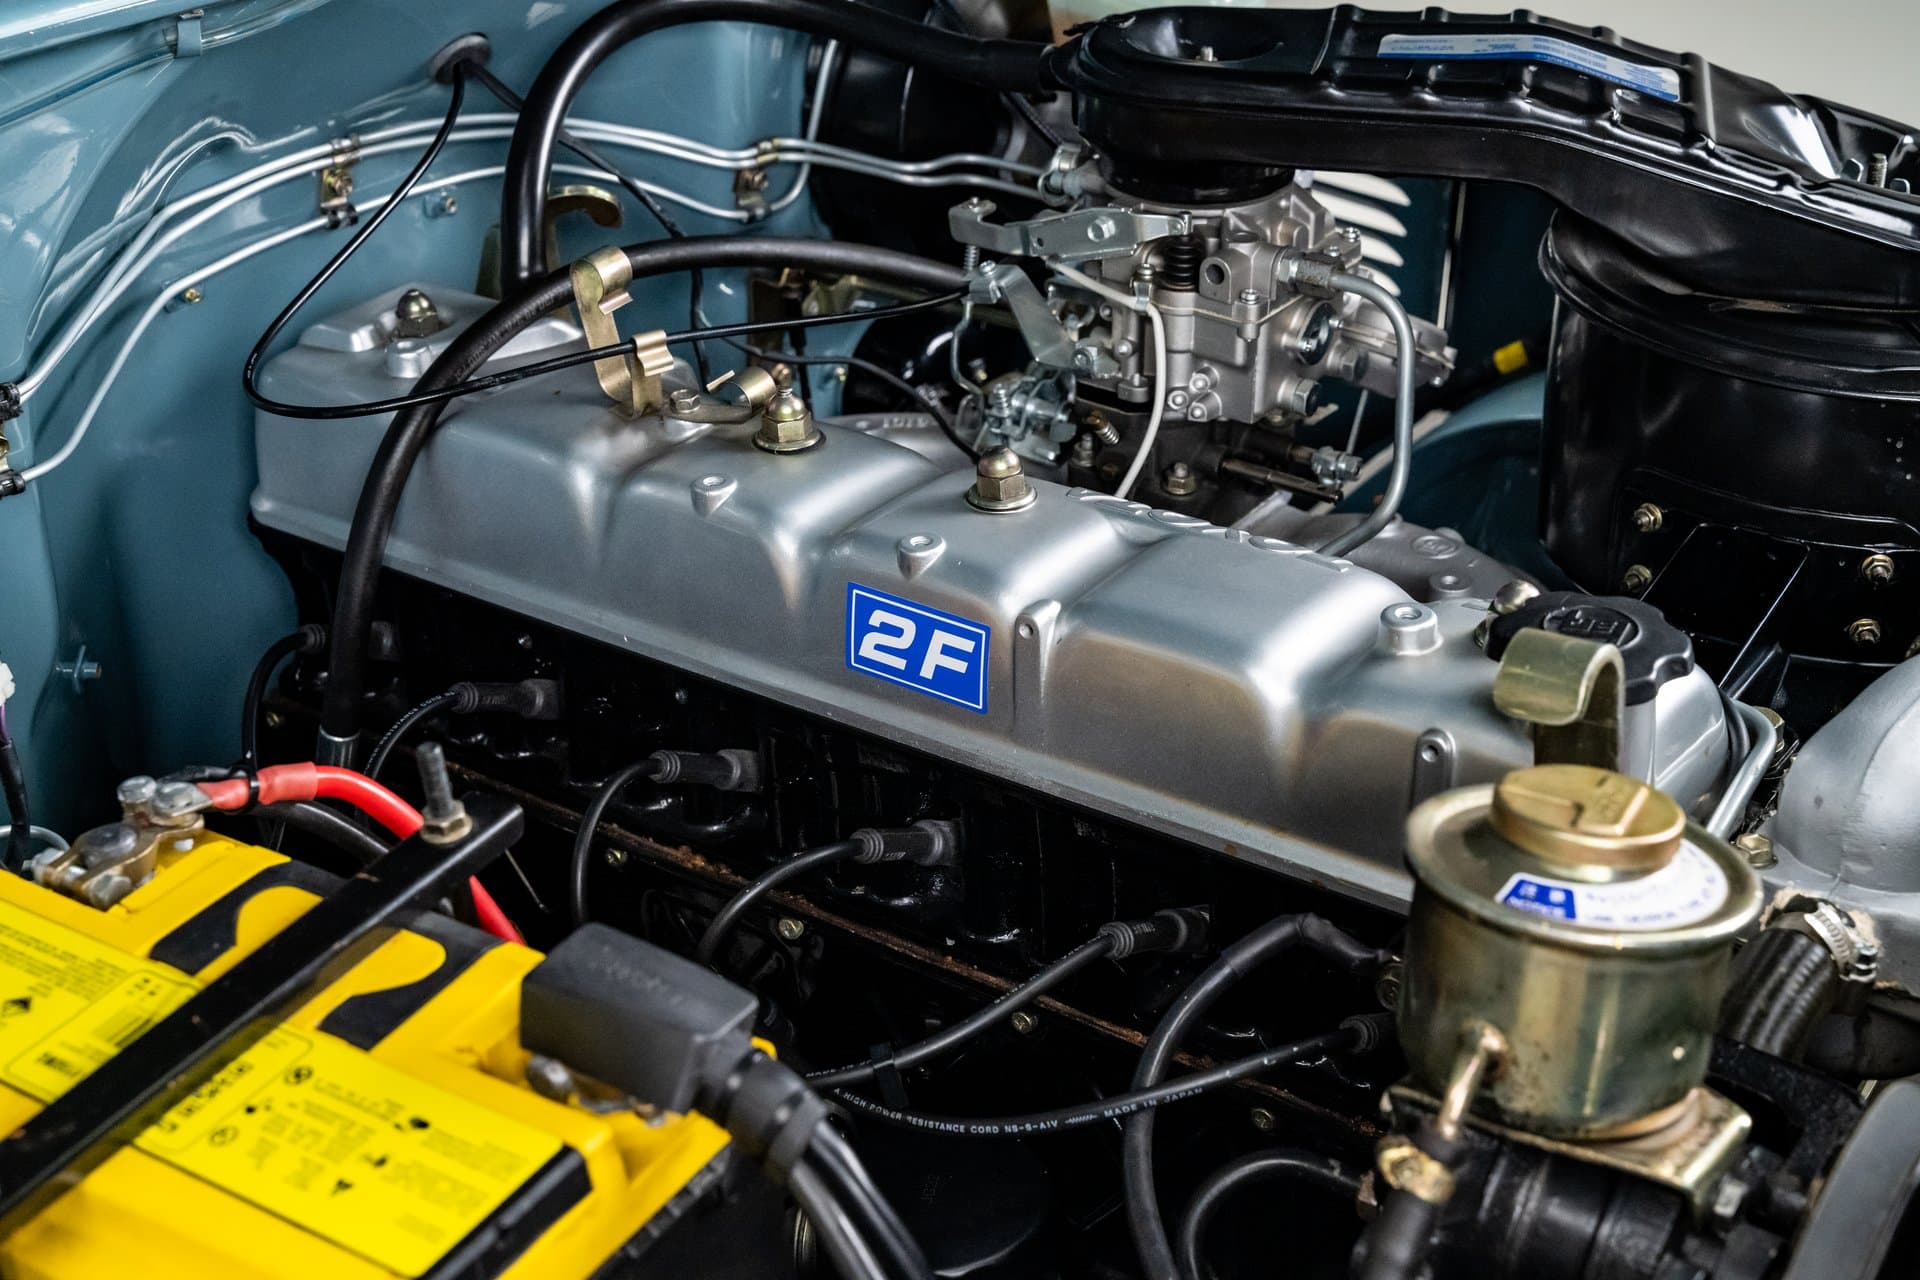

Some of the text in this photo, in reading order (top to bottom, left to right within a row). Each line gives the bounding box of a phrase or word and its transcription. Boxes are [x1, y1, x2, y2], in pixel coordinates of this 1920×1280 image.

[858, 609, 976, 680] 2F
[843, 1091, 867, 1108] HIGH
[869, 1103, 903, 1121] POWER
[906, 1115, 966, 1133] RESISTANCE
[970, 1125, 1000, 1134] CORD
[1103, 1103, 1138, 1118] MADE
[1164, 1087, 1203, 1104] JAPAN
